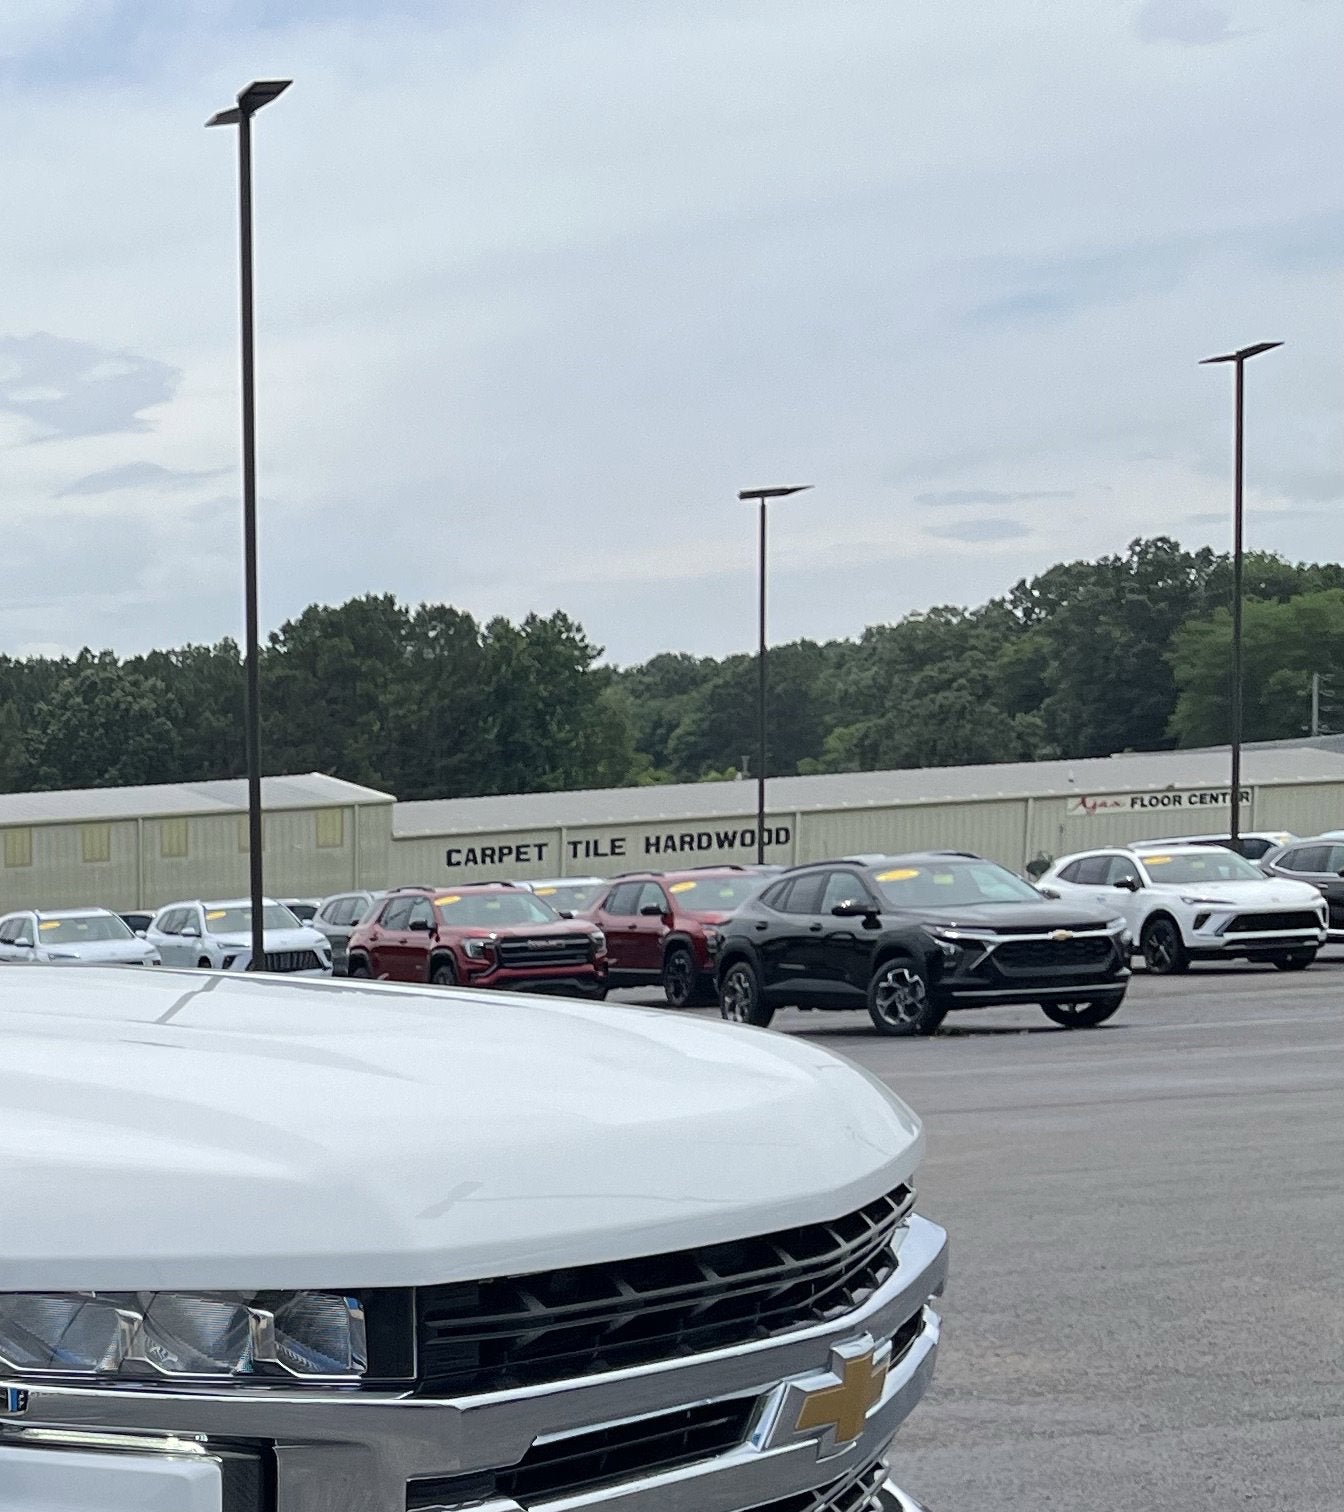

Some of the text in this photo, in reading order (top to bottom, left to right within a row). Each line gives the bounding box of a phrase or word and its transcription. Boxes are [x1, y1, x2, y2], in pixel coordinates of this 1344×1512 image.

[1130, 795, 1182, 808] FLOOR
[1188, 791, 1250, 805] CENTR
[446, 826, 791, 867] CARPET TILE HARDWOOD
